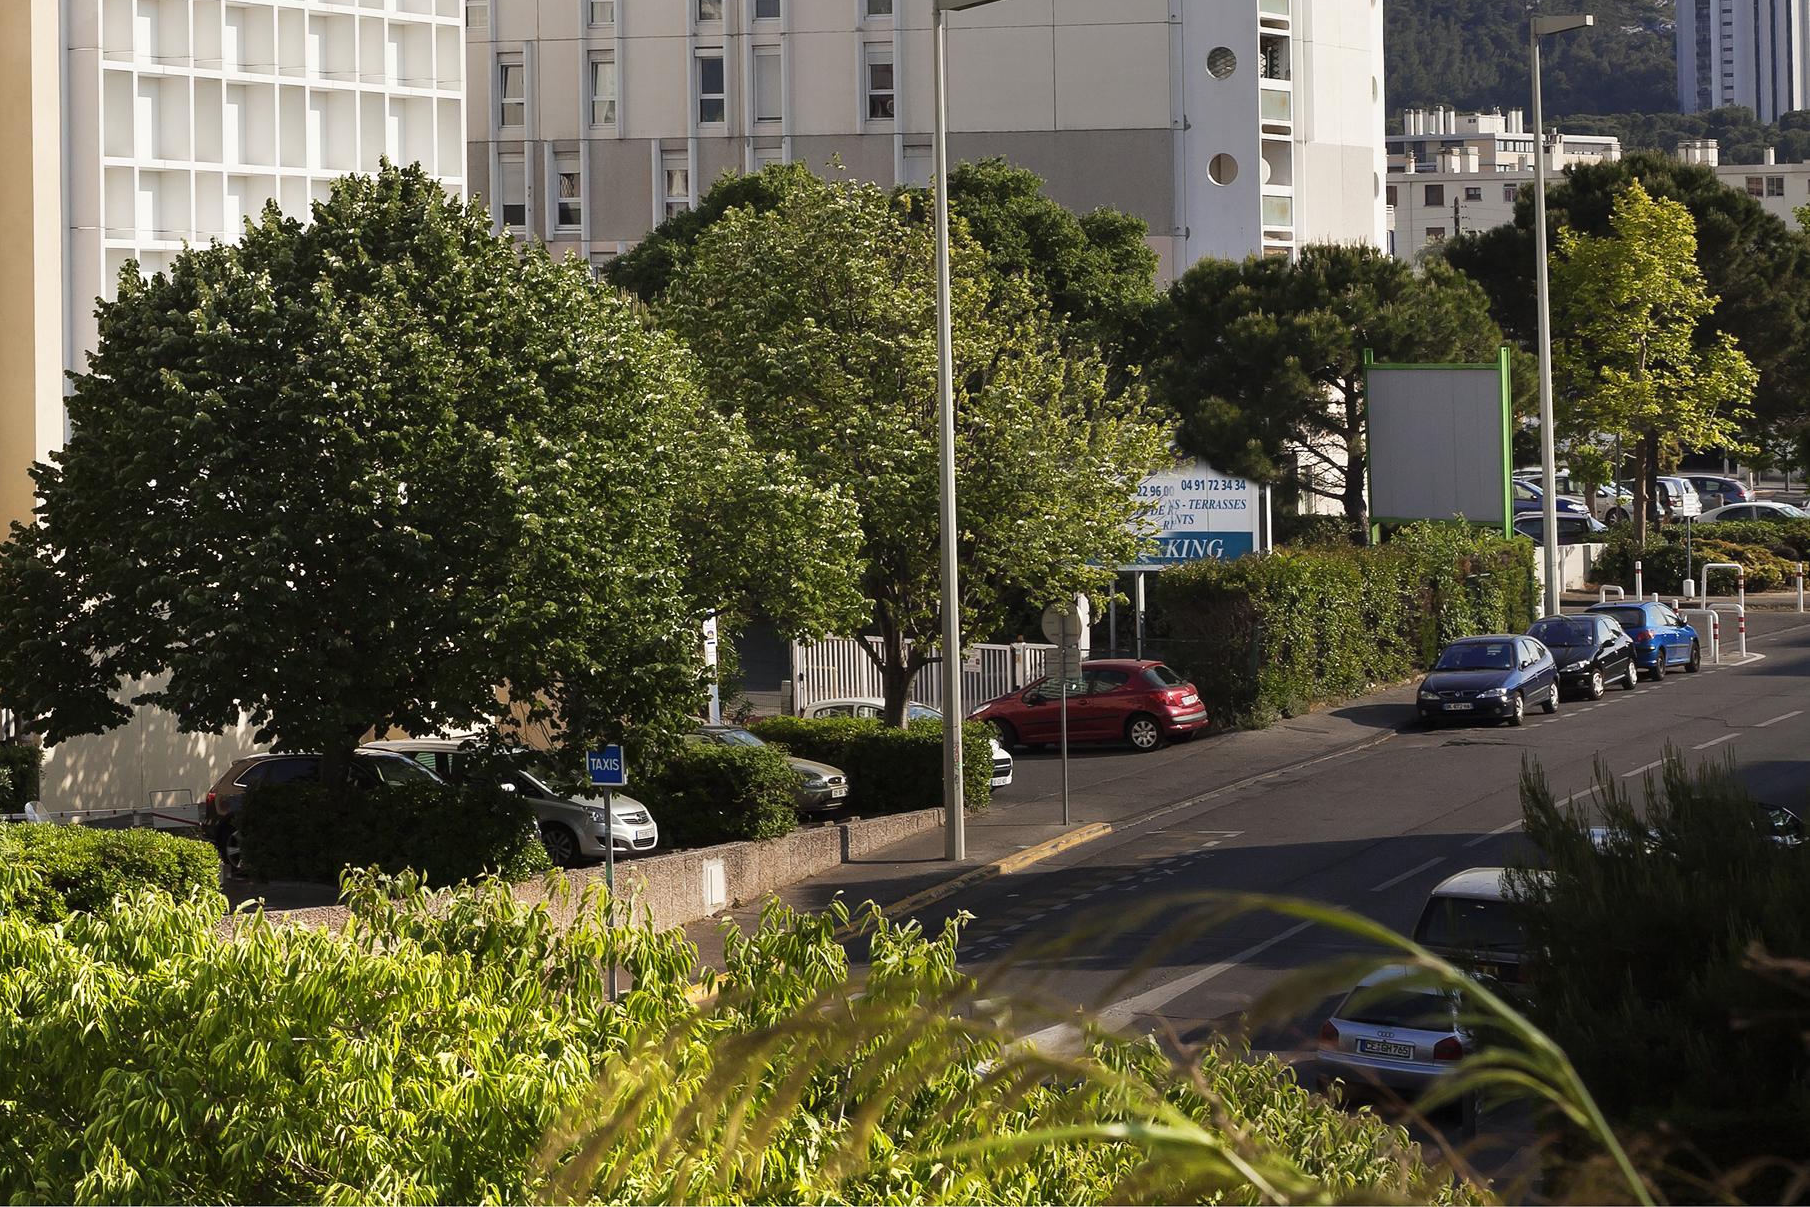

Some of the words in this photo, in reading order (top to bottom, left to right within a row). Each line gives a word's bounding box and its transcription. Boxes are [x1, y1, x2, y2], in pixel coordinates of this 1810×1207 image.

[1150, 485, 1161, 497] 96
[1181, 479, 1192, 491] 04
[1194, 479, 1205, 491] 91
[1208, 479, 1218, 491] 72
[1221, 479, 1232, 491] 34
[1235, 479, 1246, 491] 34
[1189, 499, 1247, 510] TERRASSES
[590, 758, 620, 771] TAXIS
